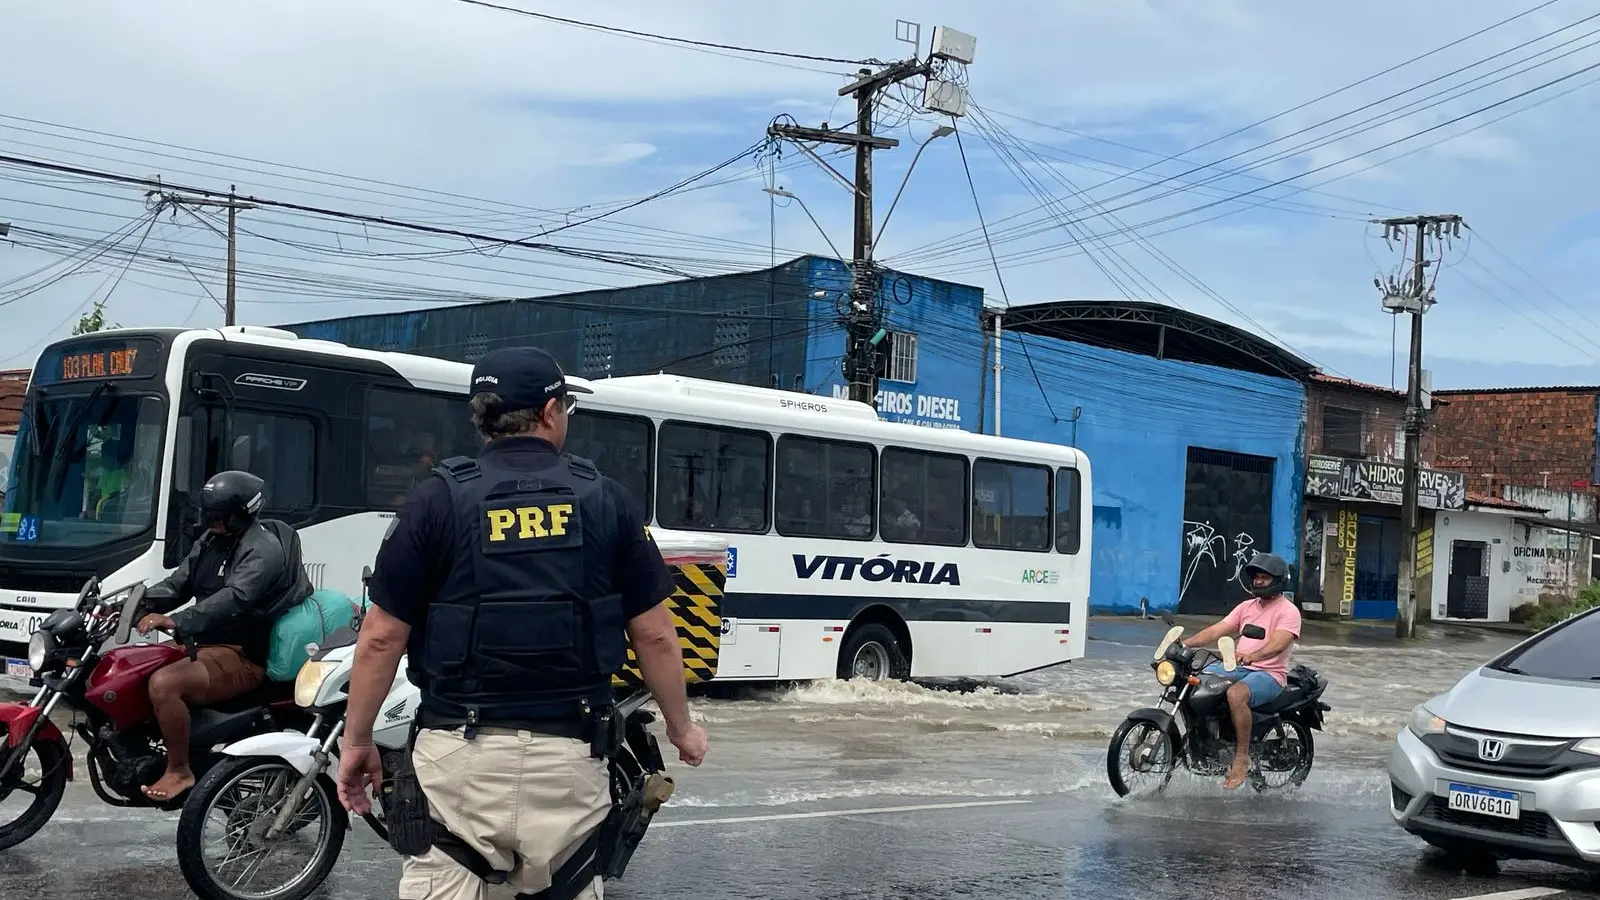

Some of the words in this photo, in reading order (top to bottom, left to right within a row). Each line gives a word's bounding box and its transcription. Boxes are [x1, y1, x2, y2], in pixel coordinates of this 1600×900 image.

[780, 399, 828, 413] SPHEROS
[832, 383, 913, 415] MEIROS
[916, 394, 961, 422] DIESEL
[1309, 459, 1342, 471] HIDROSERVE
[487, 504, 573, 542] PRF
[1513, 546, 1545, 558] OFICINA
[792, 553, 961, 586] VITÓRIA
[1022, 568, 1049, 584] ARCE
[385, 715, 411, 723] HONDA
[1455, 793, 1511, 815] ORV6G10
